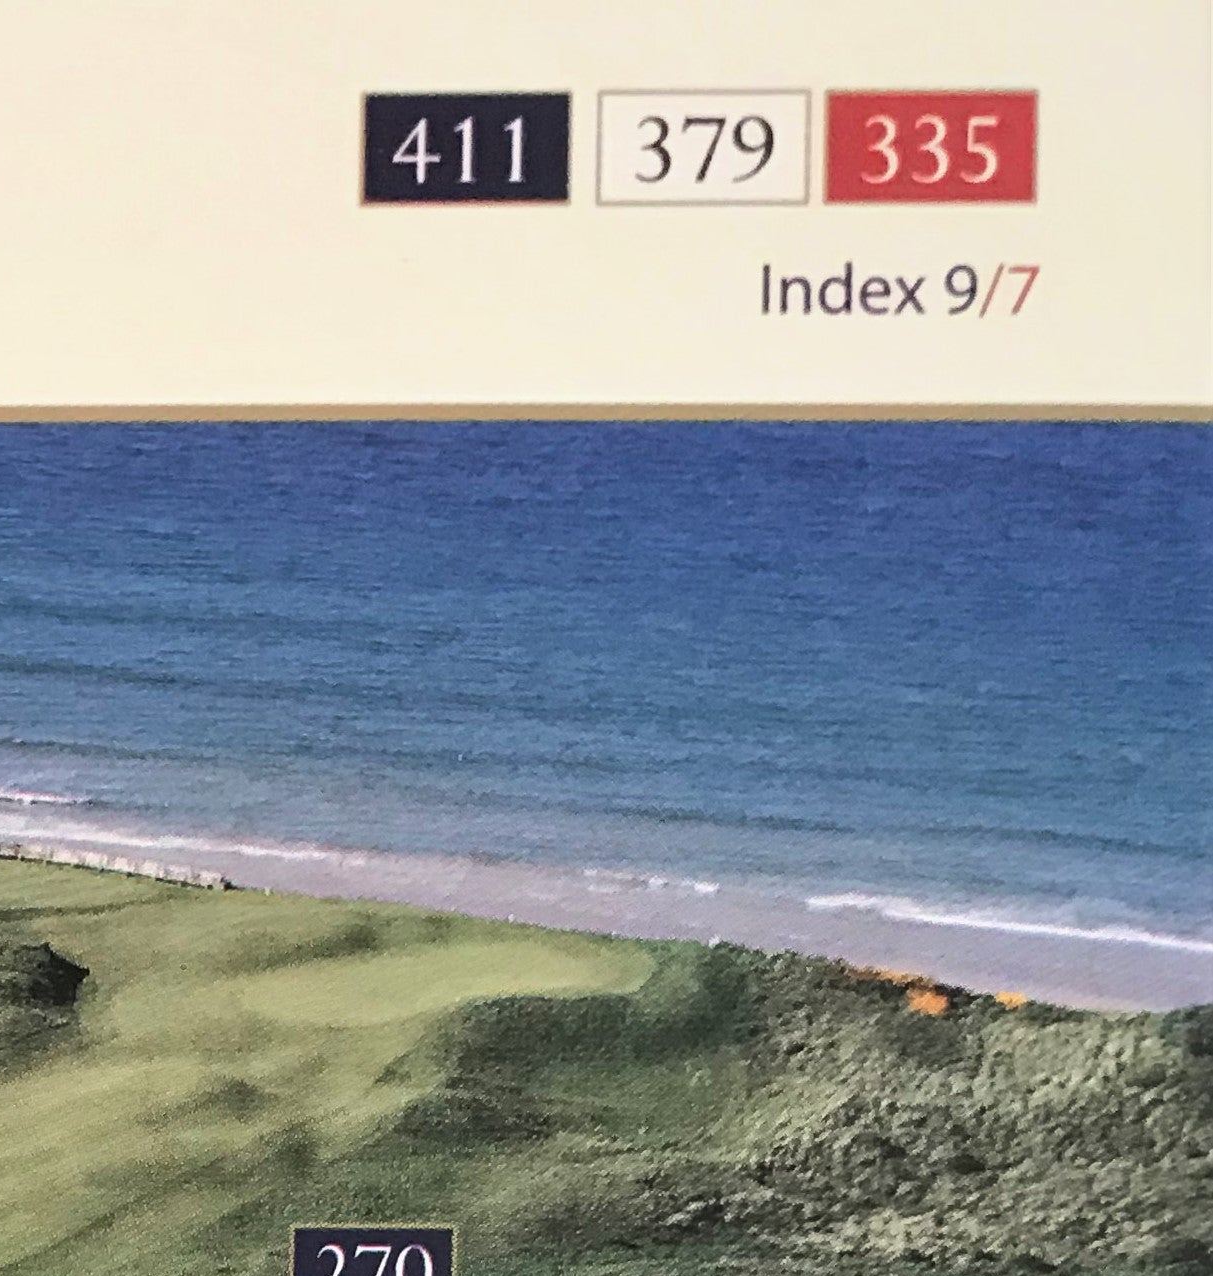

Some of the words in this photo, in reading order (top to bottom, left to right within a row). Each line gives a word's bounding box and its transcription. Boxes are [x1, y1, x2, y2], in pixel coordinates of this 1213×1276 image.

[391, 115, 528, 184] 411
[634, 115, 776, 184] 379
[861, 113, 1002, 185] 335
[760, 261, 926, 315] Index
[944, 264, 1040, 318] 9/7
